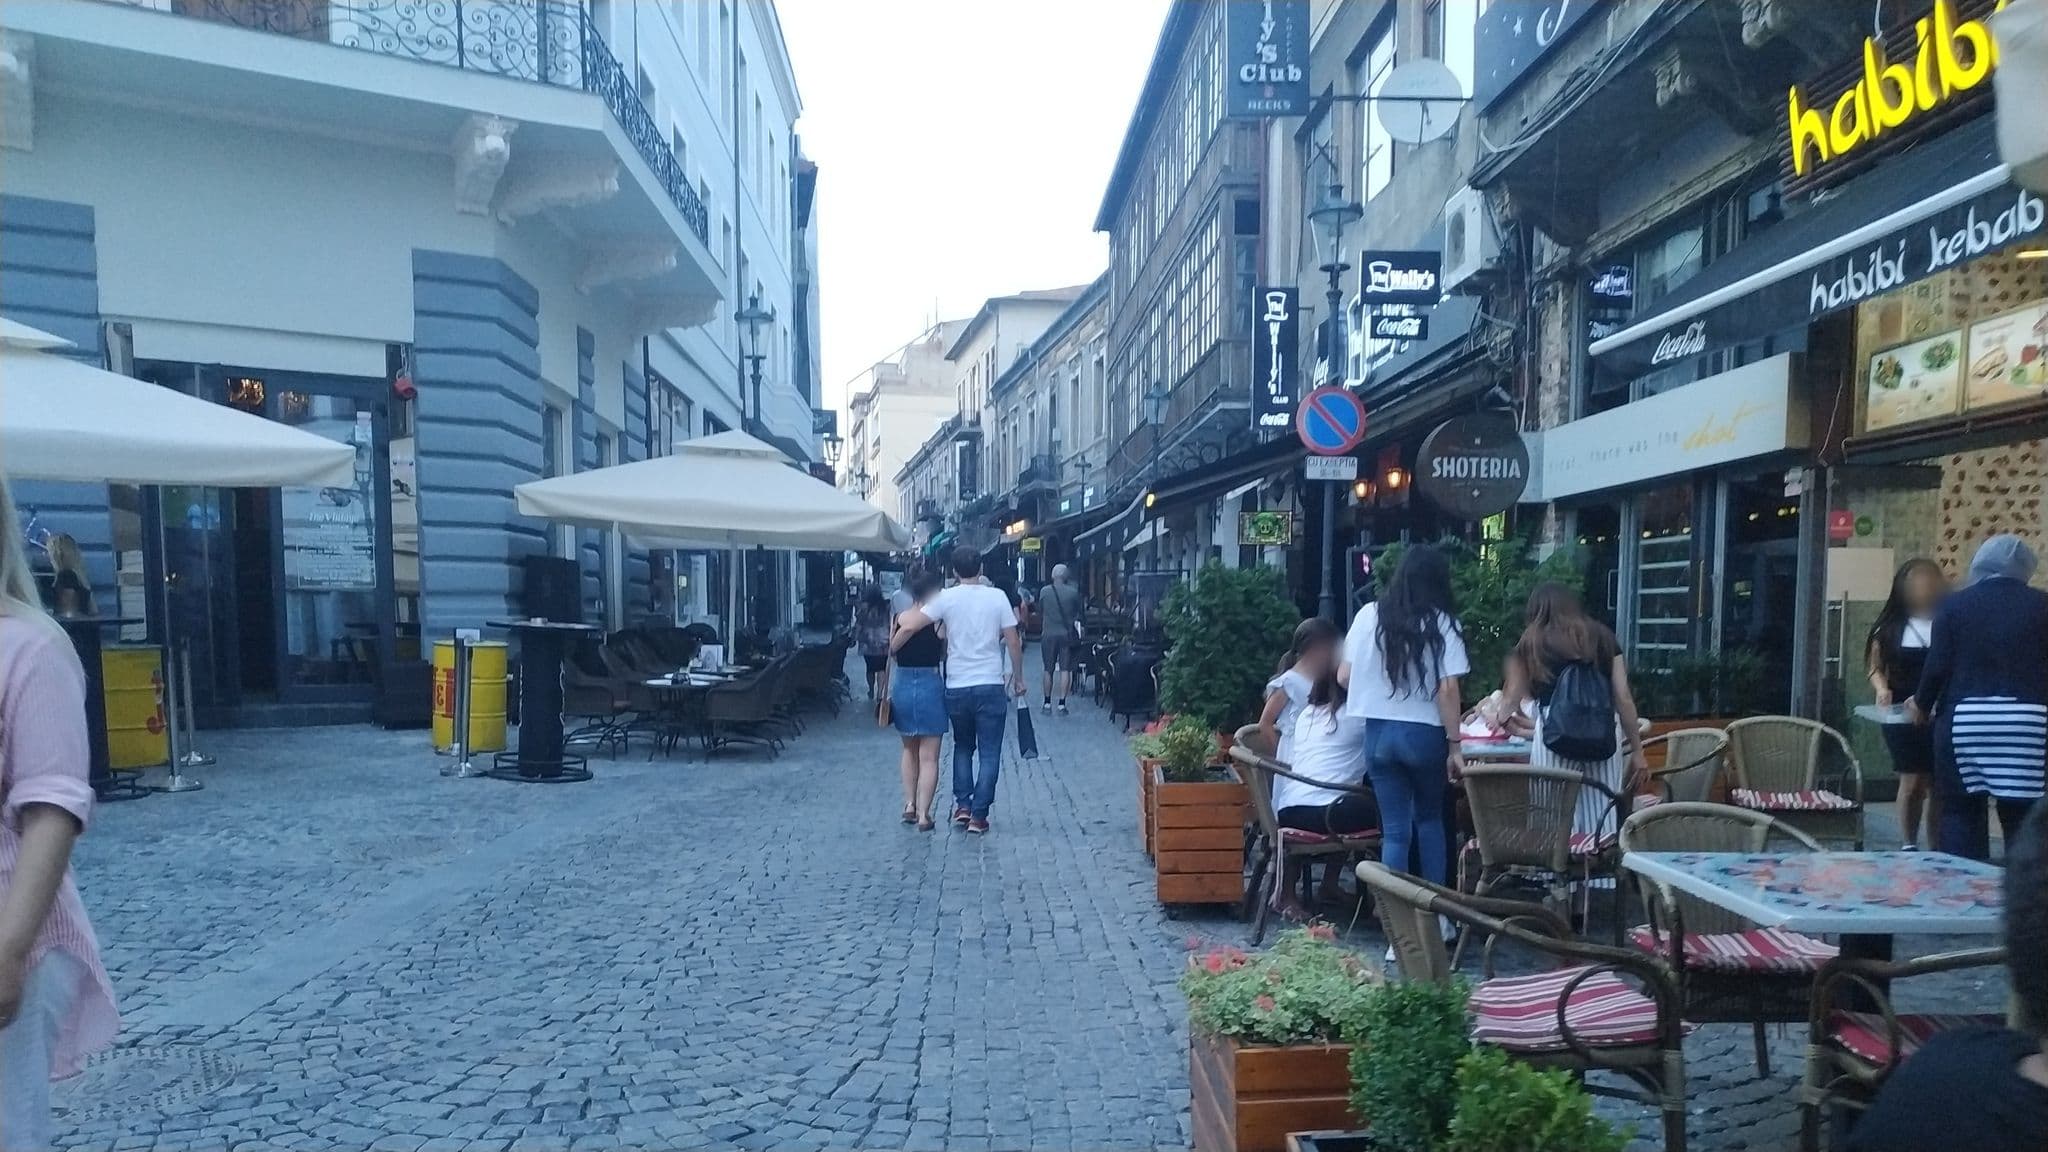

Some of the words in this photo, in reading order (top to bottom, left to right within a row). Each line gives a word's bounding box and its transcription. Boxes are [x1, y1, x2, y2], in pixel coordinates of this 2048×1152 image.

[1240, 63, 1302, 82] Club
[1810, 238, 1906, 315] habibi
[1927, 189, 2044, 273] kebab
[1390, 269, 1435, 290] Wally's
[1431, 456, 1521, 478] SHOTERIA
